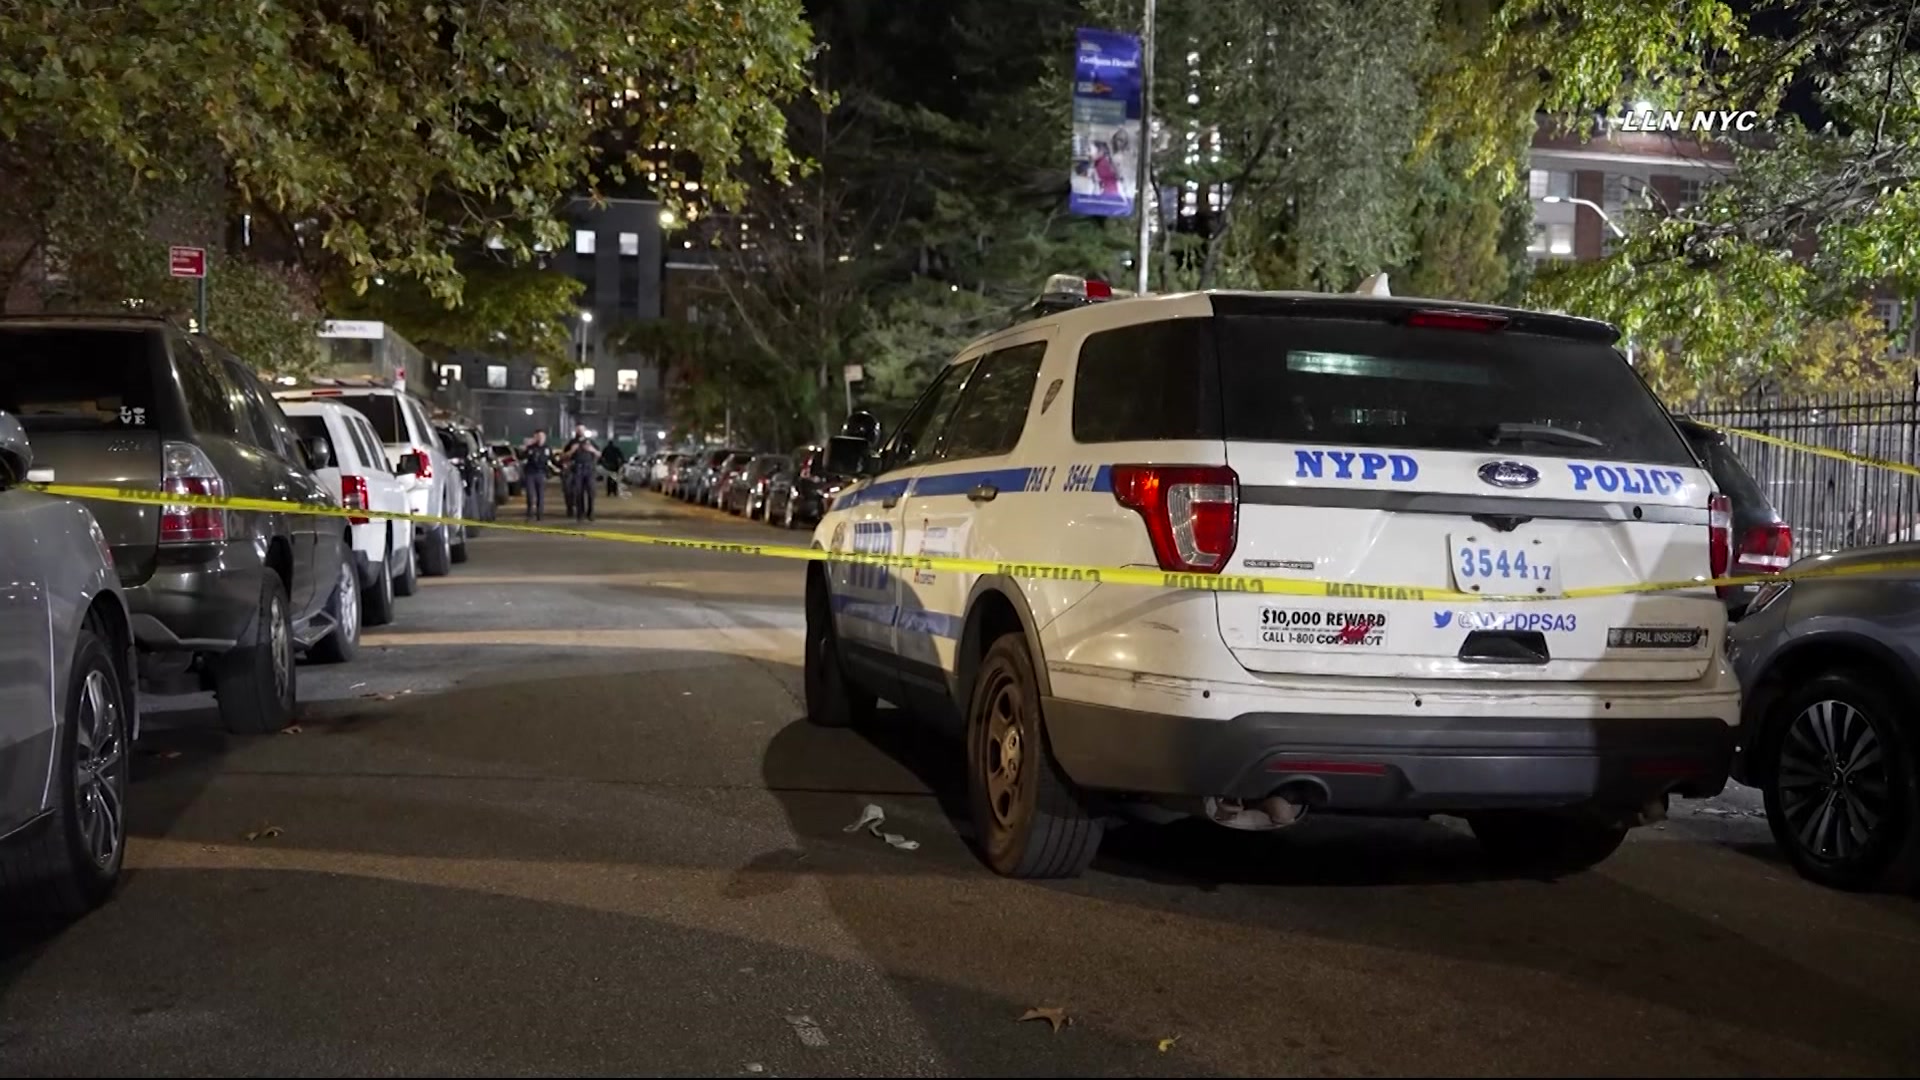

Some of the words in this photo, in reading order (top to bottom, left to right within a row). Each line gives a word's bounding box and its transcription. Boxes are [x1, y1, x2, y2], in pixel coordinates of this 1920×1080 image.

[1295, 450, 1419, 482] NYPD
[1567, 464, 1687, 495] POLICE
[1460, 548, 1528, 579] 3544
[1532, 565, 1552, 580] 17
[1262, 608, 1321, 627] $10,000
[1326, 613, 1386, 627] REWARD
[1263, 631, 1284, 643] CALL
[1289, 633, 1314, 644] 1-800
